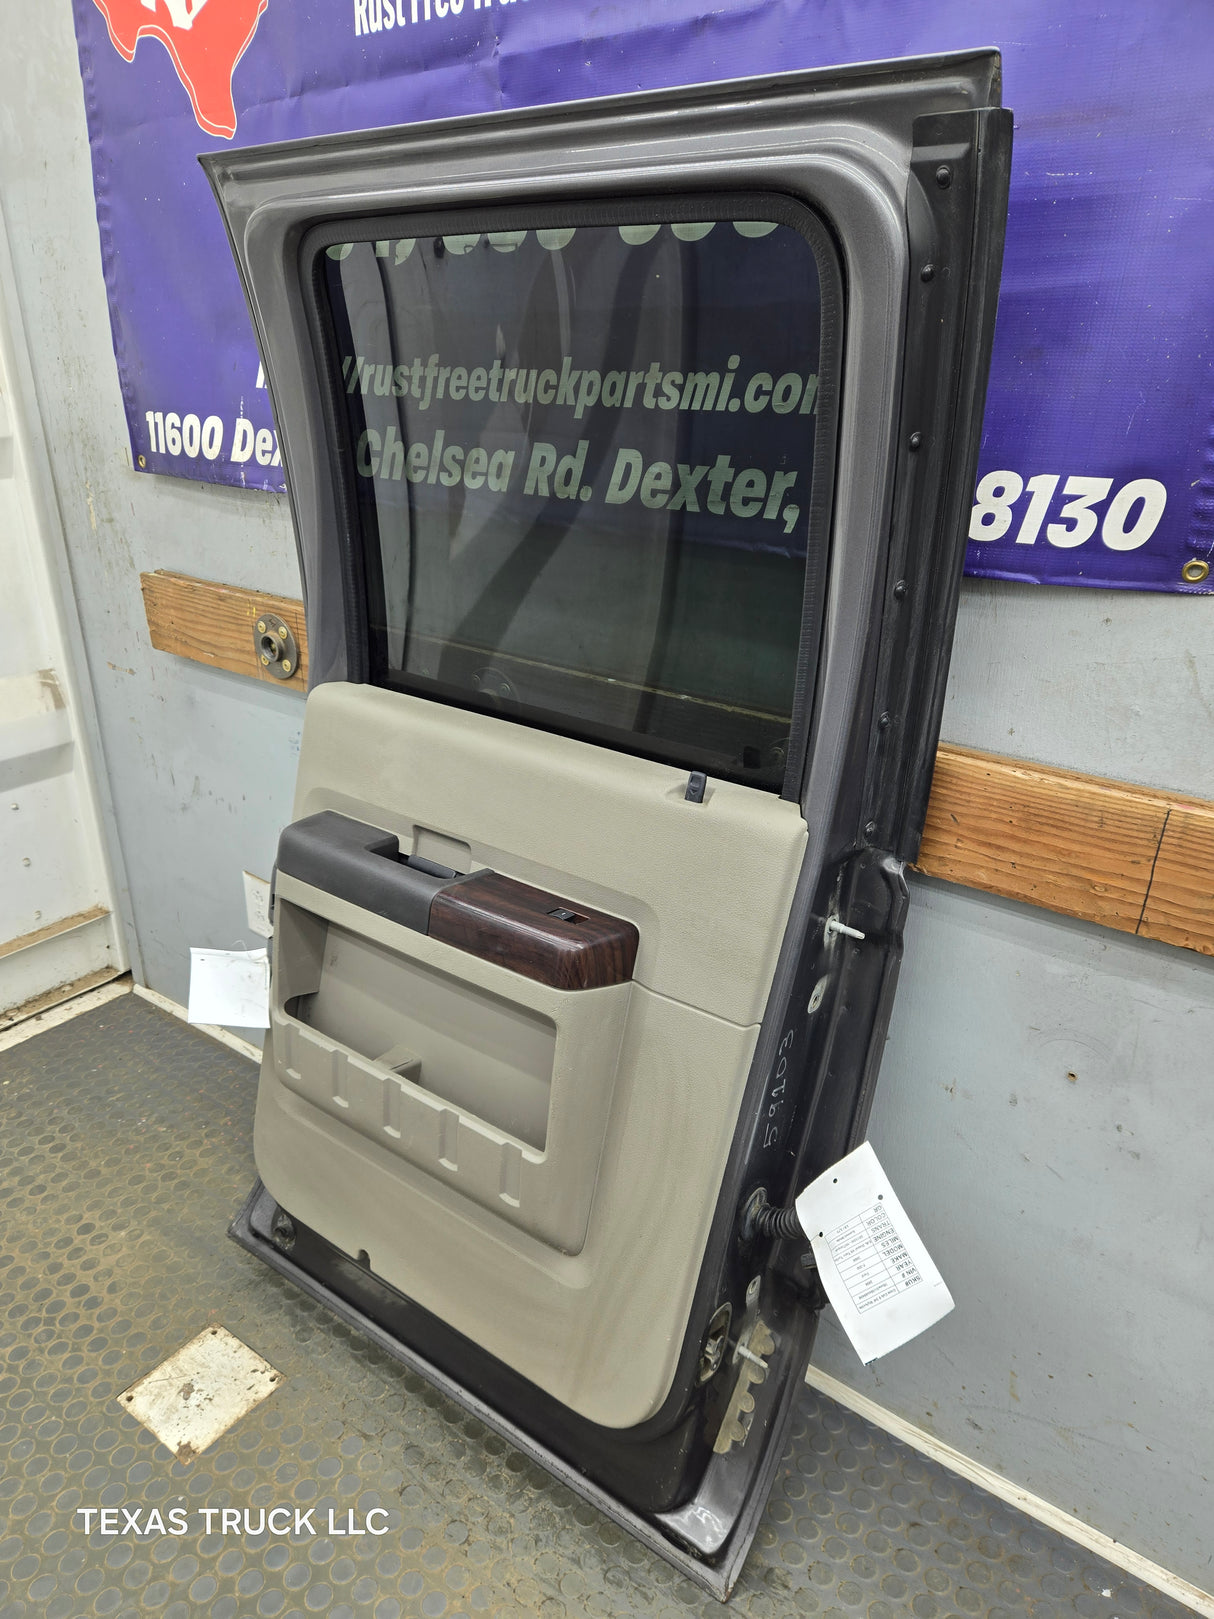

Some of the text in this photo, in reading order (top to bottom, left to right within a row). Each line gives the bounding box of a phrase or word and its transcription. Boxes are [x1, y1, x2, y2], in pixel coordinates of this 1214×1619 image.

[146, 411, 223, 460] 11600
[357, 426, 516, 492] Chelsea
[524, 440, 592, 502] Rd.
[605, 448, 800, 533] Dexter,
[968, 470, 1168, 551] 8130
[865, 1212, 885, 1225] COLOR
[870, 1220, 889, 1233] TRANS
[872, 1227, 894, 1242] ENGINE
[880, 1235, 898, 1247] MILES
[882, 1243, 903, 1256] MODEL
[890, 1251, 907, 1263] MAKE
[895, 1259, 912, 1271] YEAR
